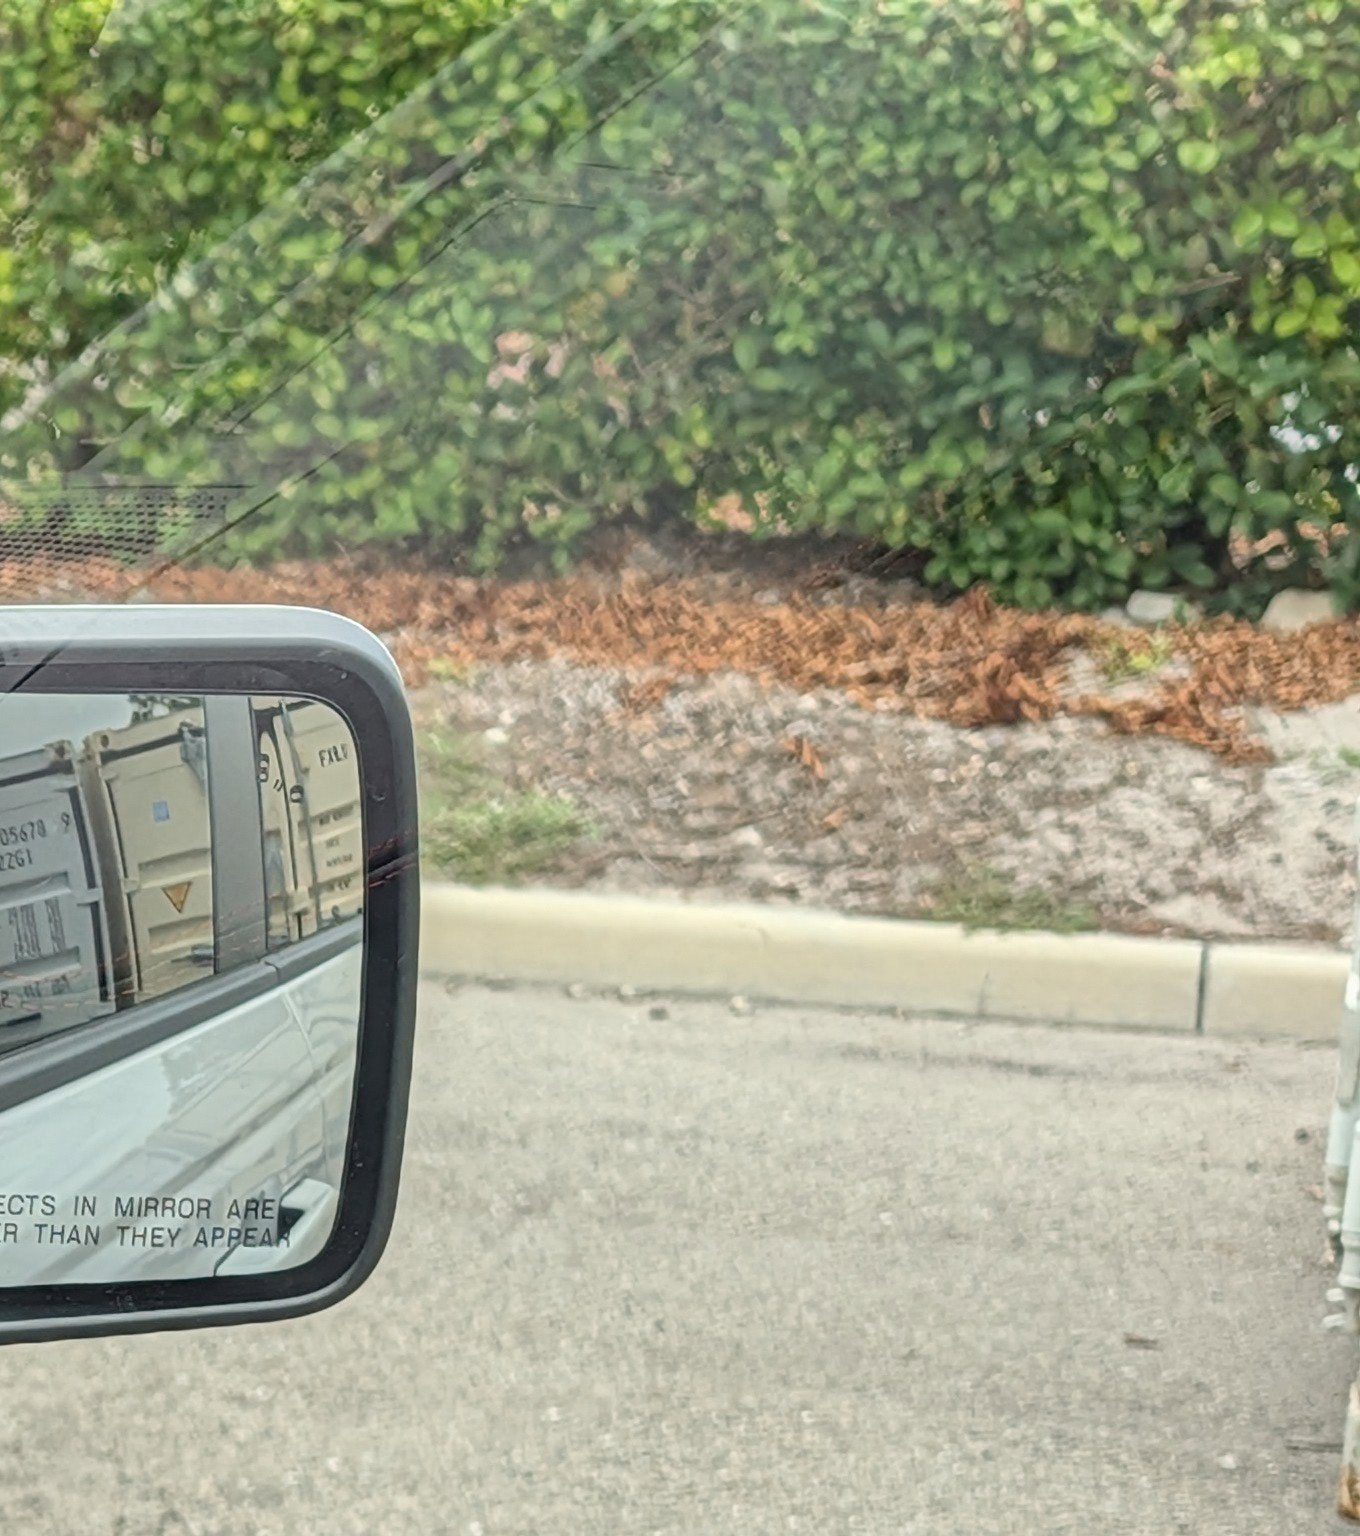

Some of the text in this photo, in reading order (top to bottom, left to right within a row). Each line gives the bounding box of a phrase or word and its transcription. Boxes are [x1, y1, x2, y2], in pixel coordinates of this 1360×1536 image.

[74, 1196, 97, 1217] IN
[114, 1196, 212, 1220] MIRROR
[226, 1198, 277, 1220] ARE
[34, 1223, 100, 1247] THAN
[116, 1225, 182, 1248] THEY
[193, 1226, 292, 1249] APPEAR
